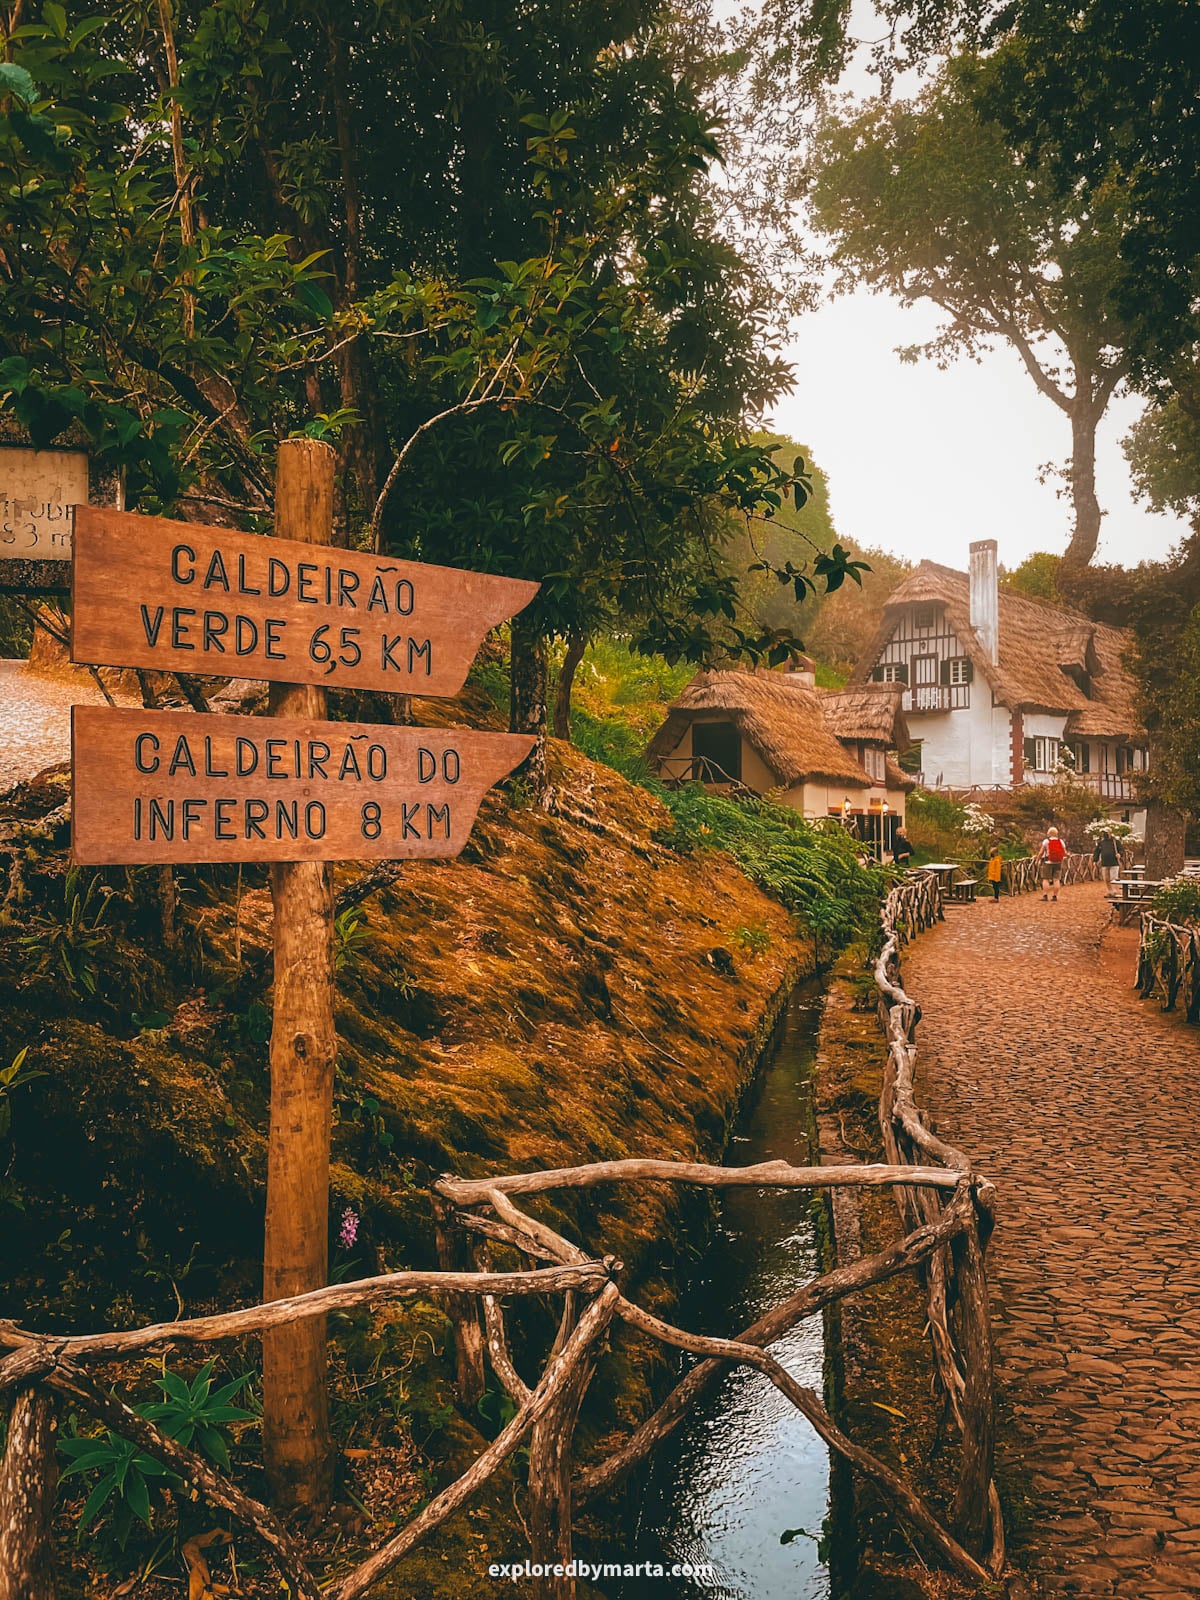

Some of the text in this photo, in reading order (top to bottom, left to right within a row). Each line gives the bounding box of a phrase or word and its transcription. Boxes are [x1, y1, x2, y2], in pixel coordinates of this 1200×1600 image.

[171, 544, 415, 616] CALDEIRÃO
[140, 604, 432, 676] VERDE 6,5 KM
[134, 732, 461, 784] CALDEIRÃO DO
[133, 797, 451, 841] INFERNO 8 KM
